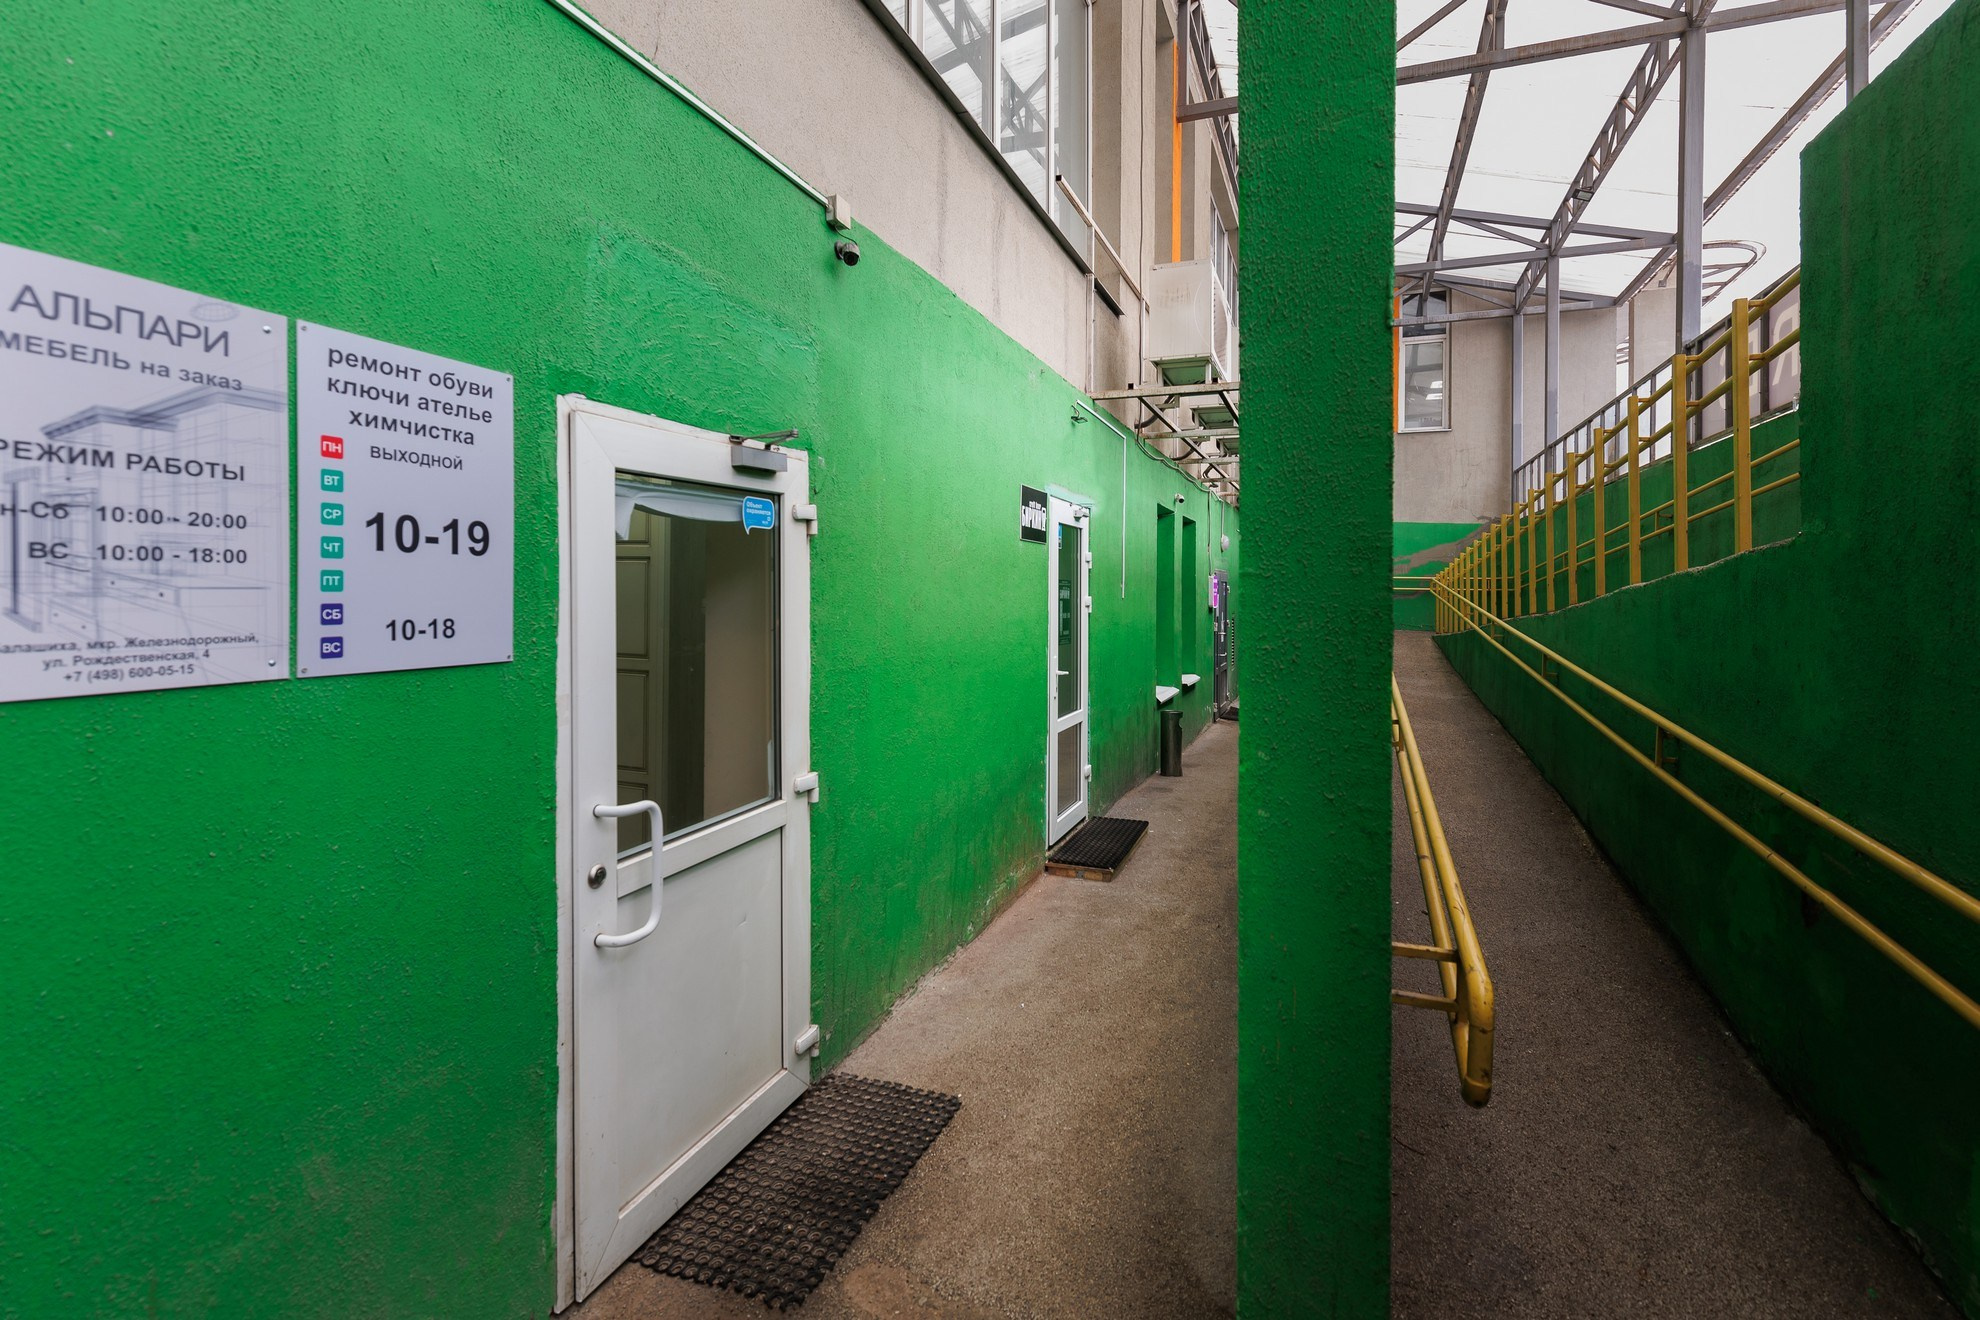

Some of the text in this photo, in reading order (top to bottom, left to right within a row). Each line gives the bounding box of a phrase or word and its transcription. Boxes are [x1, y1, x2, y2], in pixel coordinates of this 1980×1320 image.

[8, 284, 229, 357] АЛЬПАРИ
[0, 329, 243, 391] МЕБЕЛЬ на заказ
[328, 348, 494, 400] ремонт обуви
[327, 377, 493, 423] ключи ателье
[348, 409, 476, 446] химчистка
[322, 440, 343, 455] ПН
[126, 453, 244, 482] РАБОТЫ
[323, 475, 341, 487] ВТ
[96, 506, 164, 524] 10:00
[187, 512, 247, 529] 20:00
[322, 508, 342, 520] СР
[365, 512, 491, 557] 10-19
[97, 545, 164, 561] 10:00
[188, 548, 247, 564] 18:00
[322, 575, 341, 587] ПТ
[322, 609, 342, 621] СБ
[385, 618, 456, 641] 10-18
[0, 641, 82, 653] алашиха,
[124, 633, 260, 649] Железнодорожный,
[201, 648, 211, 659] 4
[322, 642, 342, 654] ВС
